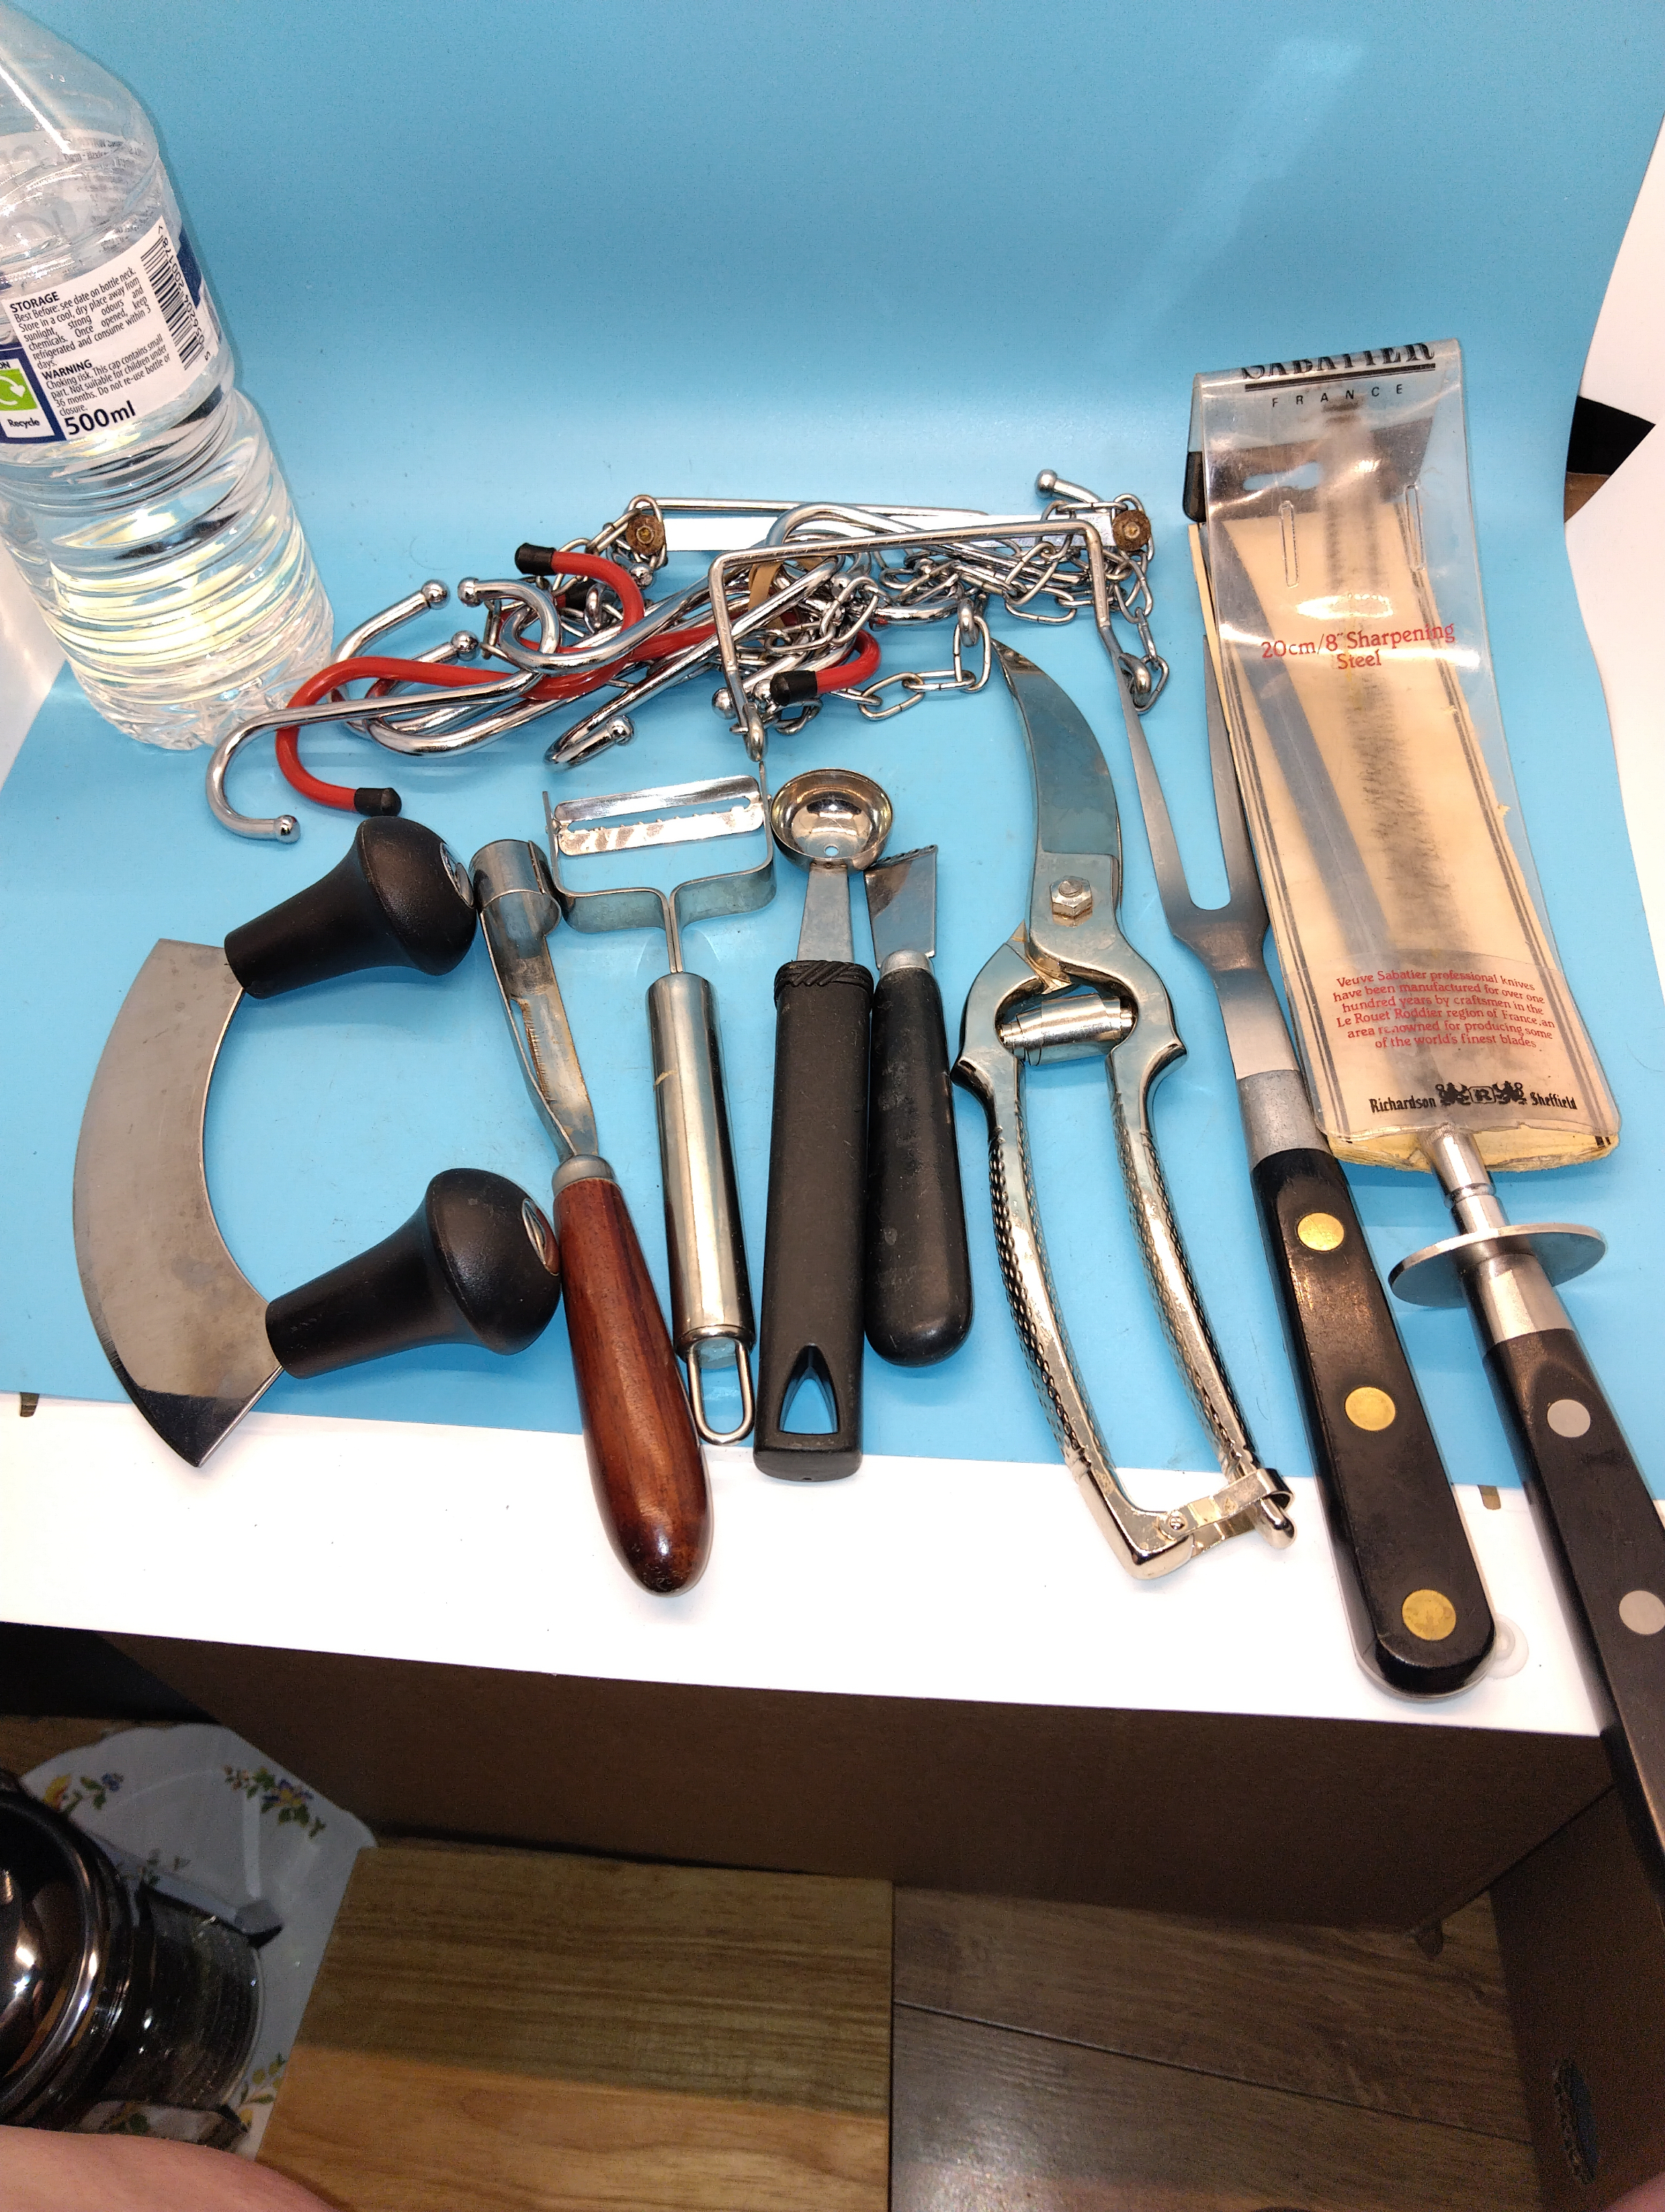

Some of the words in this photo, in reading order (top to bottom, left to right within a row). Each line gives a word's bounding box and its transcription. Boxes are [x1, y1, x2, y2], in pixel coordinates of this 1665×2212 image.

[10, 291, 60, 313] STORAGE
[14, 312, 33, 323] Best
[32, 305, 60, 319] Before:
[60, 299, 73, 310] see
[74, 293, 90, 305] date
[90, 288, 100, 298] on
[99, 277, 119, 293] bottle
[119, 267, 136, 282] neck.
[18, 321, 40, 333] Store
[40, 319, 49, 327] in
[57, 309, 75, 322] cool,
[75, 305, 88, 315] dry
[89, 296, 108, 312] place
[108, 286, 125, 301] away
[125, 277, 140, 291] from
[24, 327, 58, 341] sunlight,
[68, 315, 92, 330] strong
[101, 299, 124, 316] odours
[132, 285, 144, 299] and
[29, 335, 68, 351] chemicals.
[74, 325, 94, 338] Once
[101, 307, 128, 327] opened,
[132, 296, 147, 310] keep
[32, 341, 76, 361] refrigerated
[77, 335, 92, 348] and
[94, 322, 125, 341] consume
[125, 309, 146, 327] within
[147, 305, 151, 313] 3
[37, 360, 58, 369] days.
[41, 359, 92, 380] WARNING
[46, 376, 77, 389] Choking
[77, 370, 94, 383] risk.
[92, 365, 108, 376] This
[108, 361, 121, 370] cap
[121, 347, 148, 365] contains
[147, 333, 164, 351] small
[51, 389, 69, 400] part.
[69, 384, 84, 394] Not
[84, 374, 114, 390] suitable
[113, 369, 124, 379] for
[125, 356, 150, 375] children
[150, 344, 167, 361] under
[55, 399, 66, 408] 36
[67, 392, 97, 406] months.
[97, 386, 109, 396] Do
[110, 380, 123, 392] not
[123, 370, 145, 386] re-use
[145, 359, 163, 375] bottle
[164, 353, 171, 363] or
[1272, 383, 1402, 408] FRANCE
[59, 404, 88, 417] closure.
[64, 400, 136, 435] 500ml
[7, 417, 41, 429] Recycle
[1346, 623, 1456, 650] Sharpening
[1336, 649, 1382, 669] Steel
[1336, 974, 1374, 988] Veuve
[1377, 970, 1427, 981] Sabatier
[1430, 970, 1498, 983] professional
[1500, 975, 1535, 991] knives
[1332, 990, 1362, 1003] have
[1364, 985, 1396, 995] been
[1399, 982, 1481, 992] manufactured
[1484, 984, 1499, 995] for
[1501, 990, 1523, 1000] over
[1526, 994, 1546, 1004] one
[1342, 995, 1397, 1013] hundred
[1399, 996, 1433, 1008] years
[1434, 995, 1450, 1007] by
[1453, 995, 1511, 1009] craftsmen
[1512, 1001, 1525, 1011] in
[1527, 1003, 1545, 1015] the
[1336, 1016, 1352, 1028] Le
[1353, 1011, 1391, 1025] Rouet
[1394, 1007, 1442, 1020] Roddier
[1446, 1008, 1484, 1020] region
[1487, 1009, 1498, 1018] of
[1347, 1026, 1375, 1039] area
[1444, 1020, 1461, 1032] for
[1464, 1020, 1524, 1039] producing
[1525, 1027, 1554, 1040] some
[1375, 1037, 1388, 1048] of
[1390, 1037, 1412, 1047] the
[1414, 1032, 1458, 1045] world's
[1461, 1034, 1497, 1044] finest
[1369, 1096, 1436, 1113] Richardson
[1530, 1092, 1578, 1110] Sheffield
